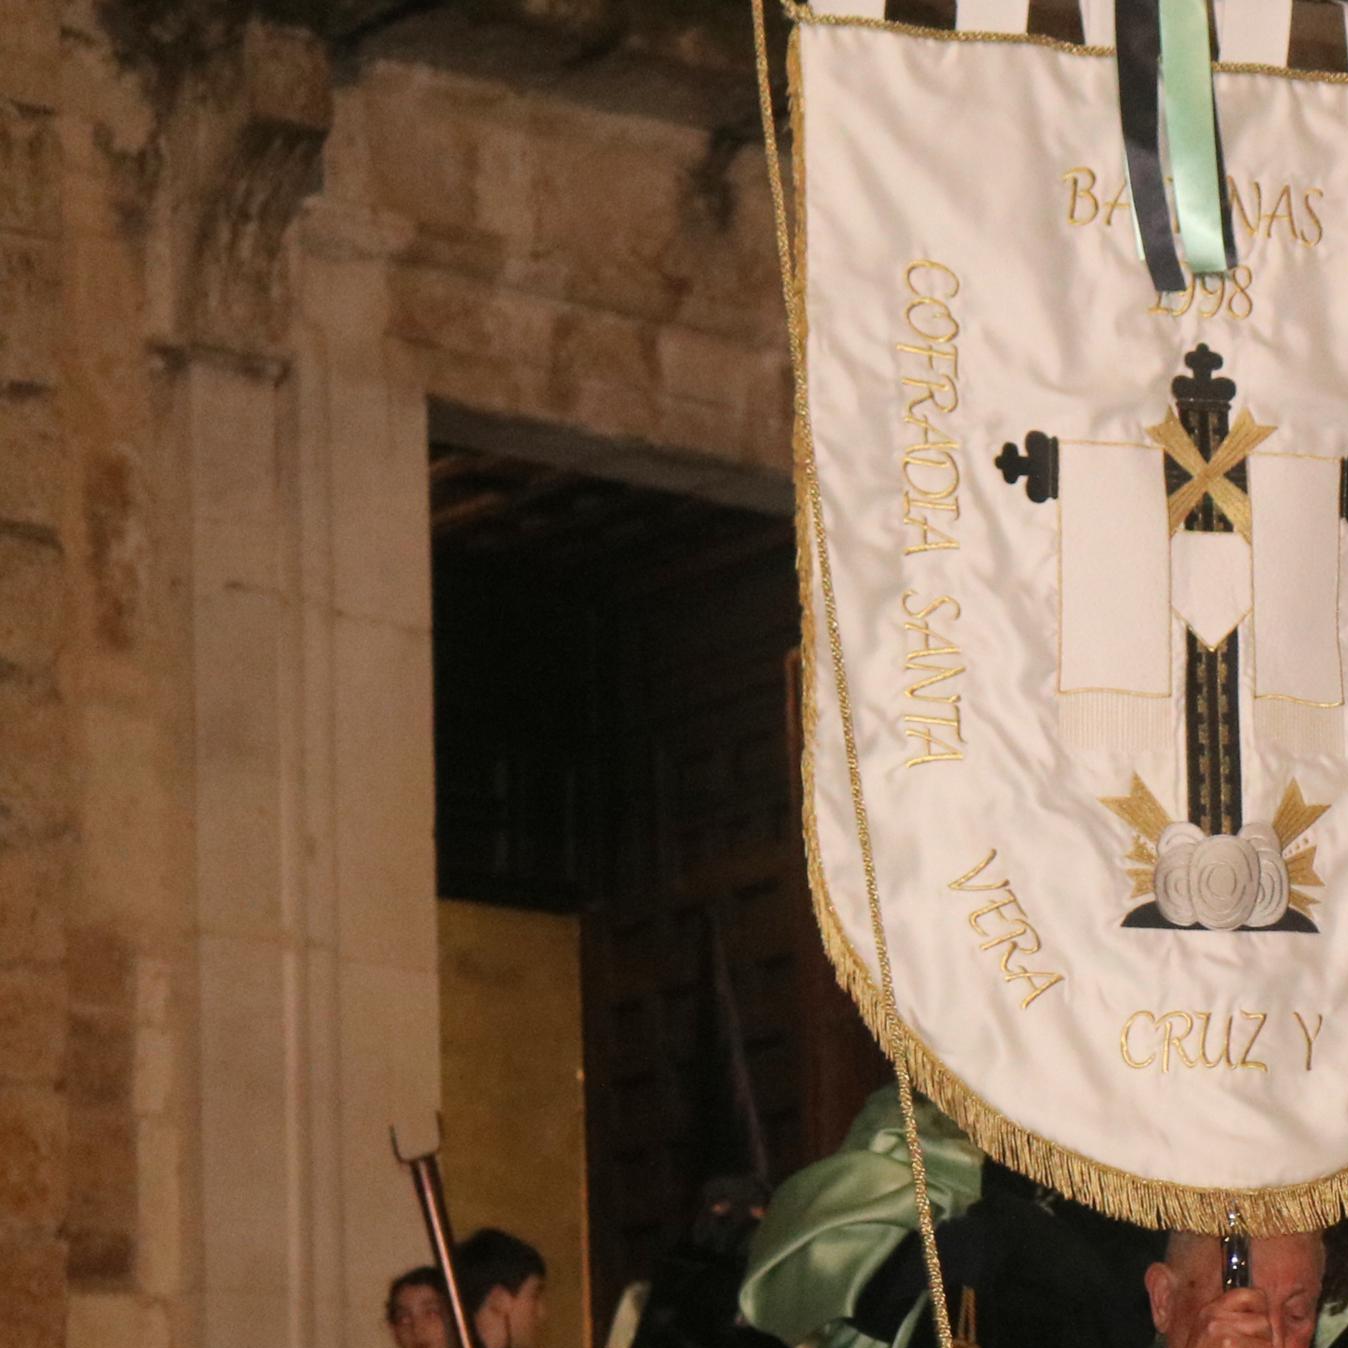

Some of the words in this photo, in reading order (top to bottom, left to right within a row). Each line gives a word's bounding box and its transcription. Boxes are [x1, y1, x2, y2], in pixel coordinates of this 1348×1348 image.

[1063, 167, 1324, 247] BANAS
[897, 258, 960, 556] COFRADIA
[900, 589, 966, 769] SANTA
[947, 848, 1065, 1009] VERA
[1120, 1009, 1268, 1073] CRUZ
[1294, 1011, 1323, 1072] Y
